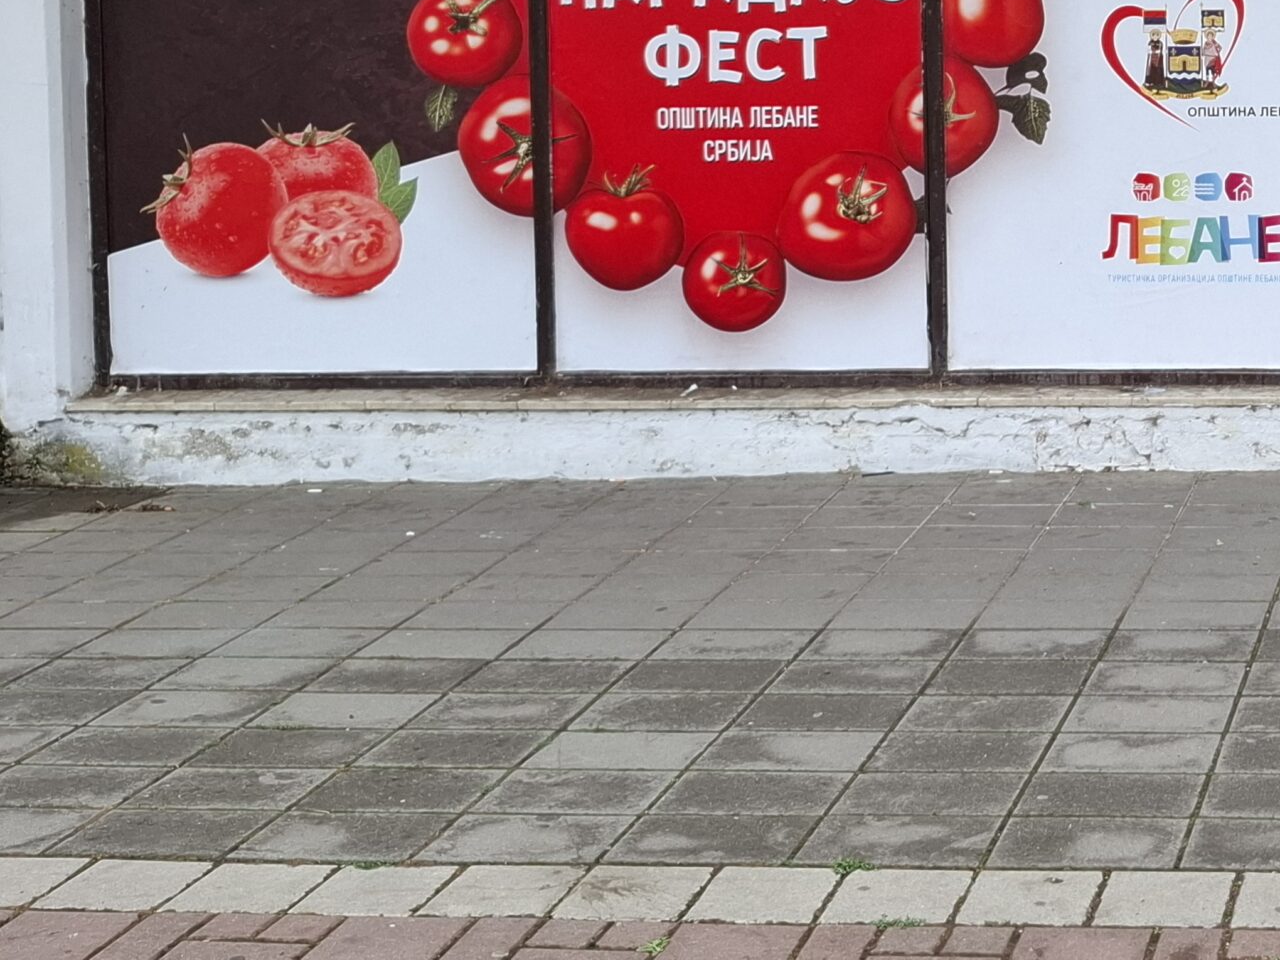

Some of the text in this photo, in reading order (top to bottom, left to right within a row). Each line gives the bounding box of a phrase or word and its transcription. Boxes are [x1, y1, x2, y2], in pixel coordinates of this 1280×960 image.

[644, 24, 828, 87] ФЕСТ
[656, 105, 820, 131] ОПШТИНА ЛЕБАНЕ
[1187, 106, 1257, 118] ОПШТИНА
[703, 140, 774, 163] СРБИЈА
[1107, 273, 1156, 283] ТУРИСТИЧКА
[1157, 273, 1216, 284] ОРГАНИЗАЦИЈА
[1217, 273, 1253, 283] ОПШТИНЕ
